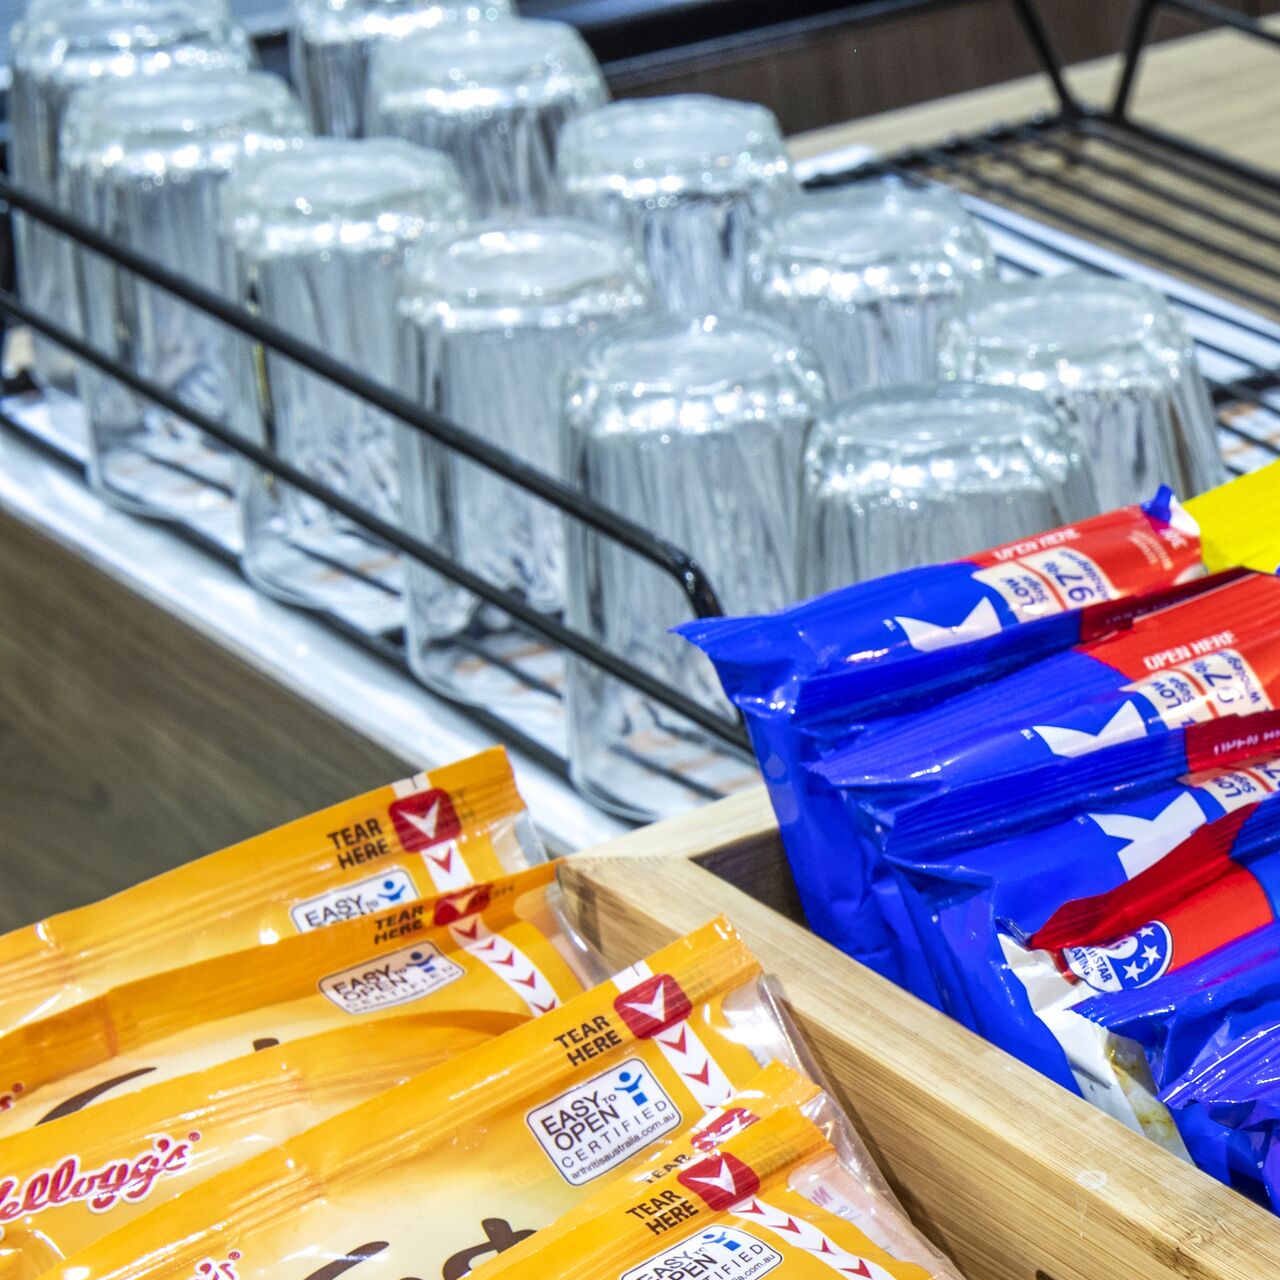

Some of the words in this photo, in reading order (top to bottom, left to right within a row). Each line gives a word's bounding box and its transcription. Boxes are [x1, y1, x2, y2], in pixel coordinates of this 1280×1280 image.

[327, 818, 383, 850] TEAR
[337, 838, 391, 870] HERE
[305, 894, 364, 928] EASY
[374, 905, 424, 931] TEAR
[373, 919, 424, 945] HERE
[333, 964, 394, 995] EASY
[1094, 955, 1112, 983] STAR
[343, 976, 408, 1002] OPEN
[553, 1015, 611, 1050] TEAR
[566, 1029, 623, 1067] HERE
[541, 1091, 599, 1136] EASY
[602, 1093, 617, 1106] TO
[554, 1104, 620, 1151] OPEN
[561, 1100, 667, 1169] CERTIFIED
[571, 1112, 676, 1180] arthritisaustralia.com.au
[643, 1153, 690, 1184] TEAR
[625, 1189, 682, 1220] TEAR
[645, 1200, 699, 1235] HERE
